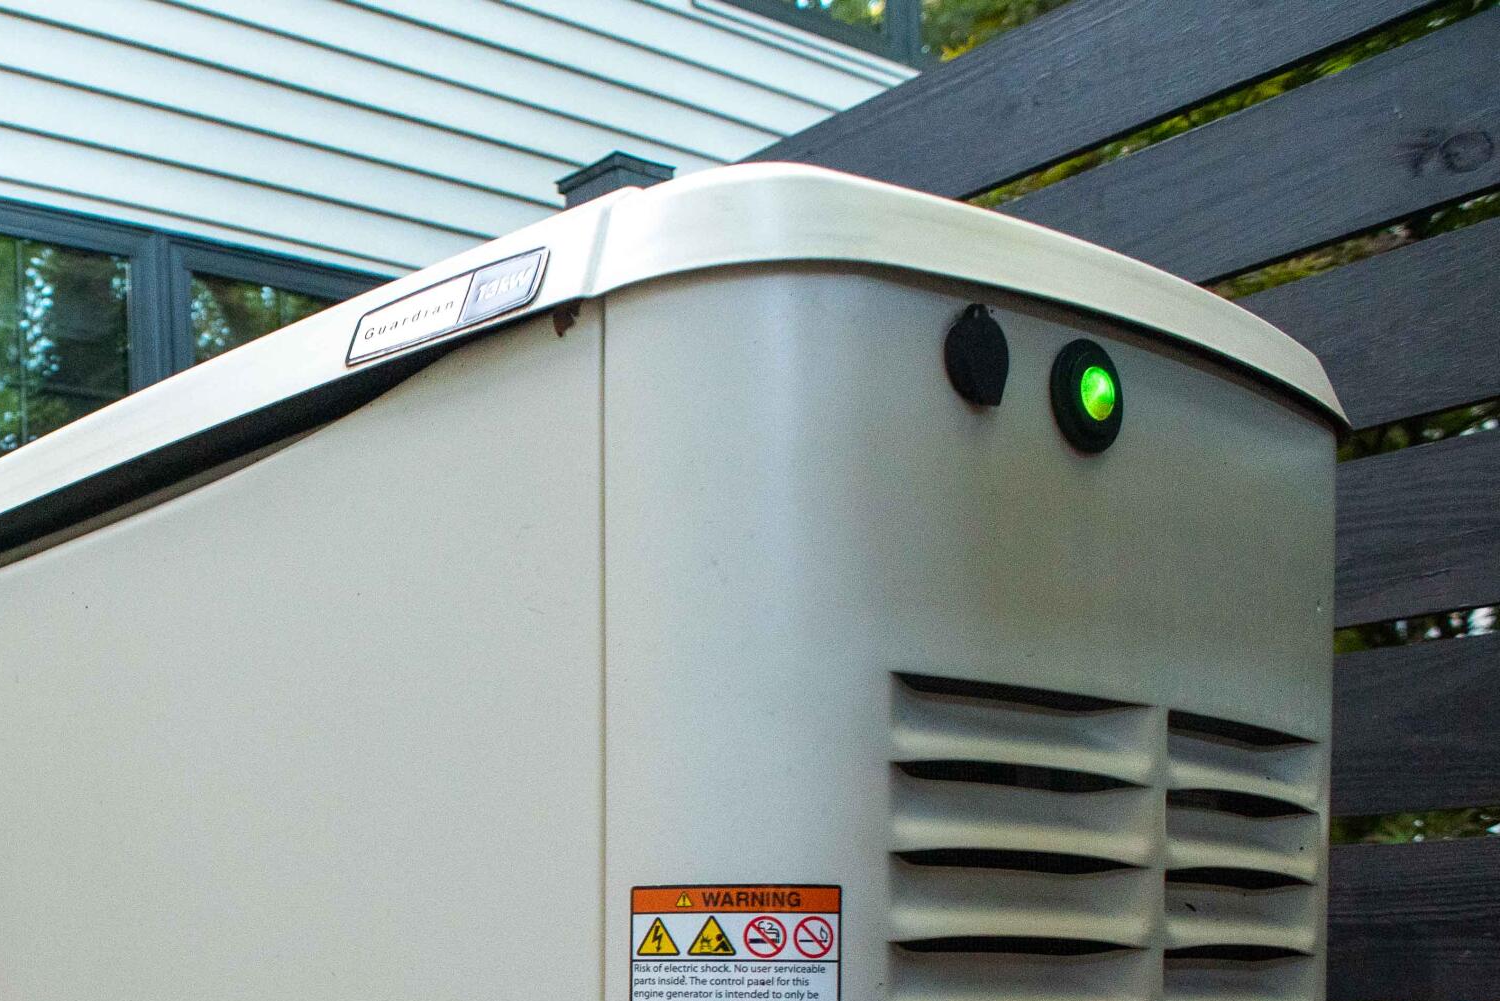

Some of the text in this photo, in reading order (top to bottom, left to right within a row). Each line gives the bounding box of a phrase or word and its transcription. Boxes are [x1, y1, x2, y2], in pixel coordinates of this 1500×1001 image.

[364, 299, 454, 340] Guardian
[701, 891, 802, 908] WARNING
[633, 964, 652, 973] Risk
[652, 964, 663, 973] of
[663, 964, 699, 973] electric
[700, 964, 732, 973] shock.
[733, 964, 749, 973] No
[773, 964, 826, 974] serviceable
[633, 976, 809, 988] parts inside. The control panel for this
[633, 989, 819, 1001] engine generator is intended to only be
